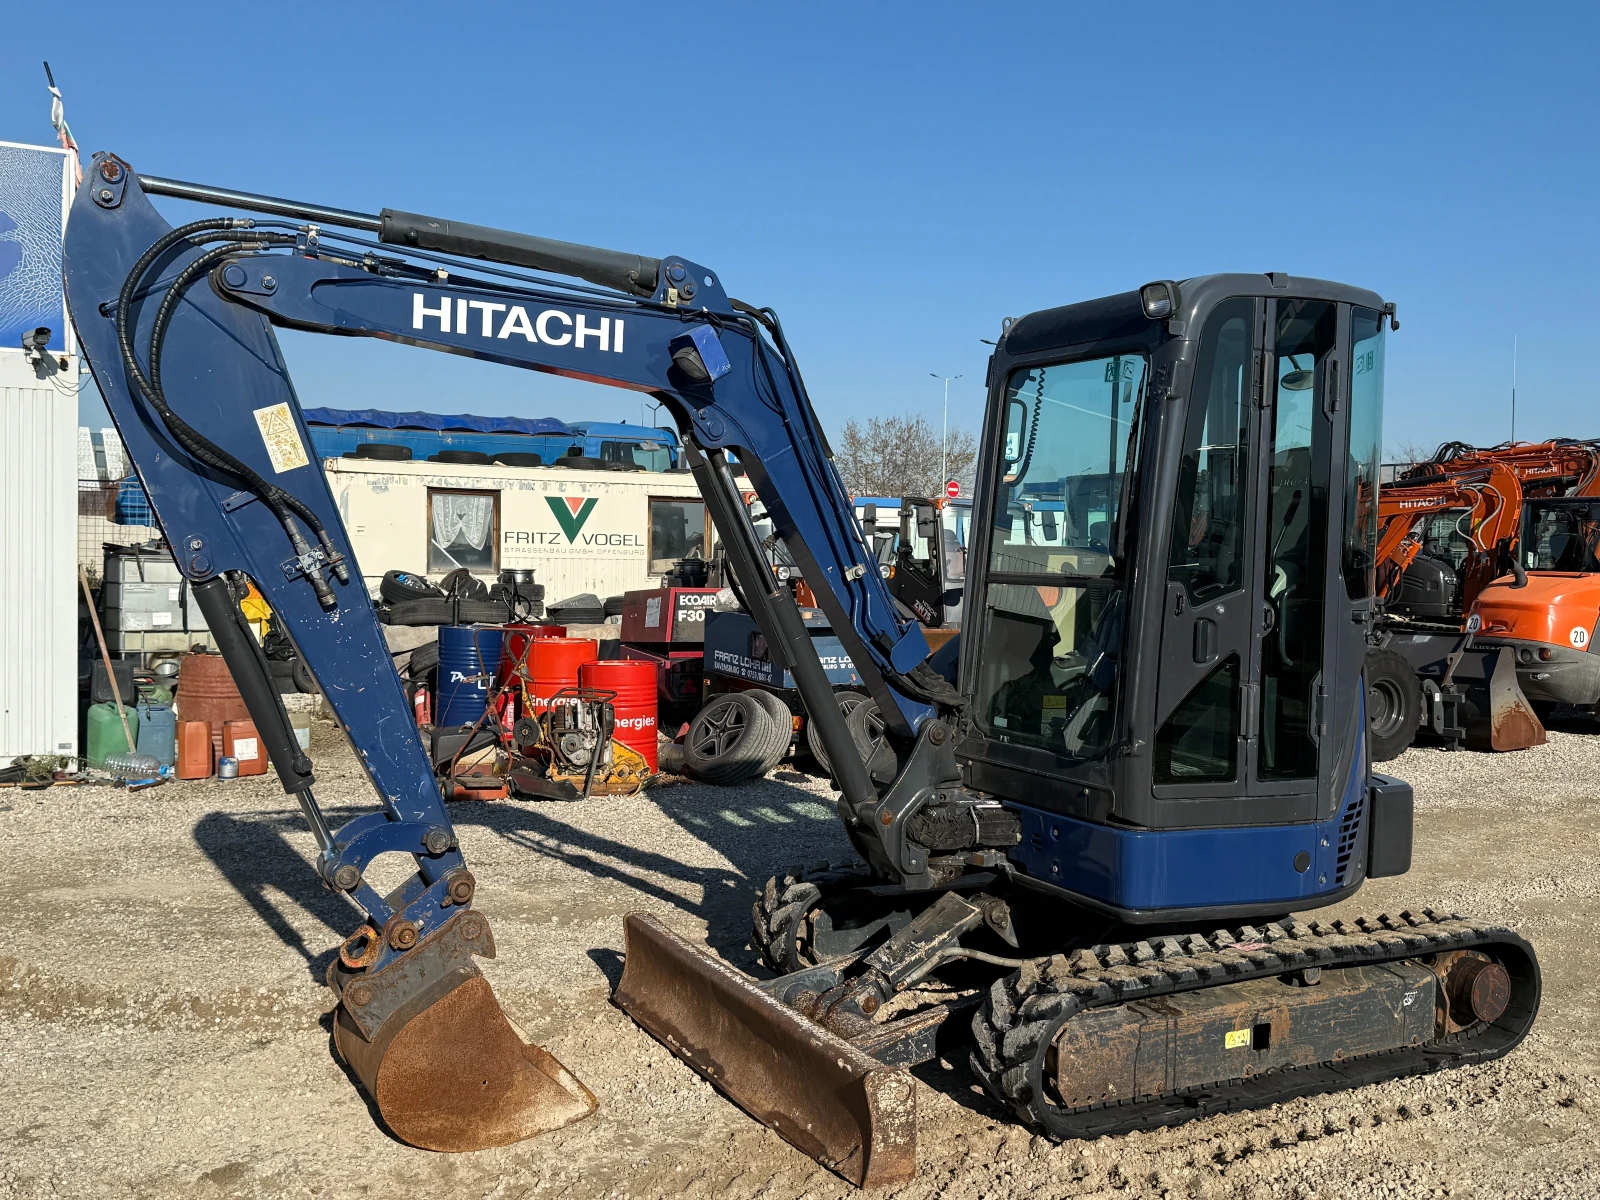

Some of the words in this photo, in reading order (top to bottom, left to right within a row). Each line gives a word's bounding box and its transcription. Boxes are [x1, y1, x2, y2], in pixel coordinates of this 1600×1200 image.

[412, 293, 624, 353] HITACHI
[1525, 466, 1558, 475] HITACHI
[1399, 496, 1447, 509] HITACHI
[504, 531, 561, 545] FRITZ
[582, 533, 645, 547] VOGEL
[680, 595, 716, 606] ECOAIR
[914, 599, 931, 621] ZW75
[922, 599, 937, 618] HITACHI
[678, 610, 705, 622] F30
[1468, 617, 1479, 630] 20
[1573, 630, 1585, 643] 20
[714, 661, 740, 675] RAVENSBURG
[740, 656, 760, 670] LOHR
[614, 715, 655, 730] nergies
